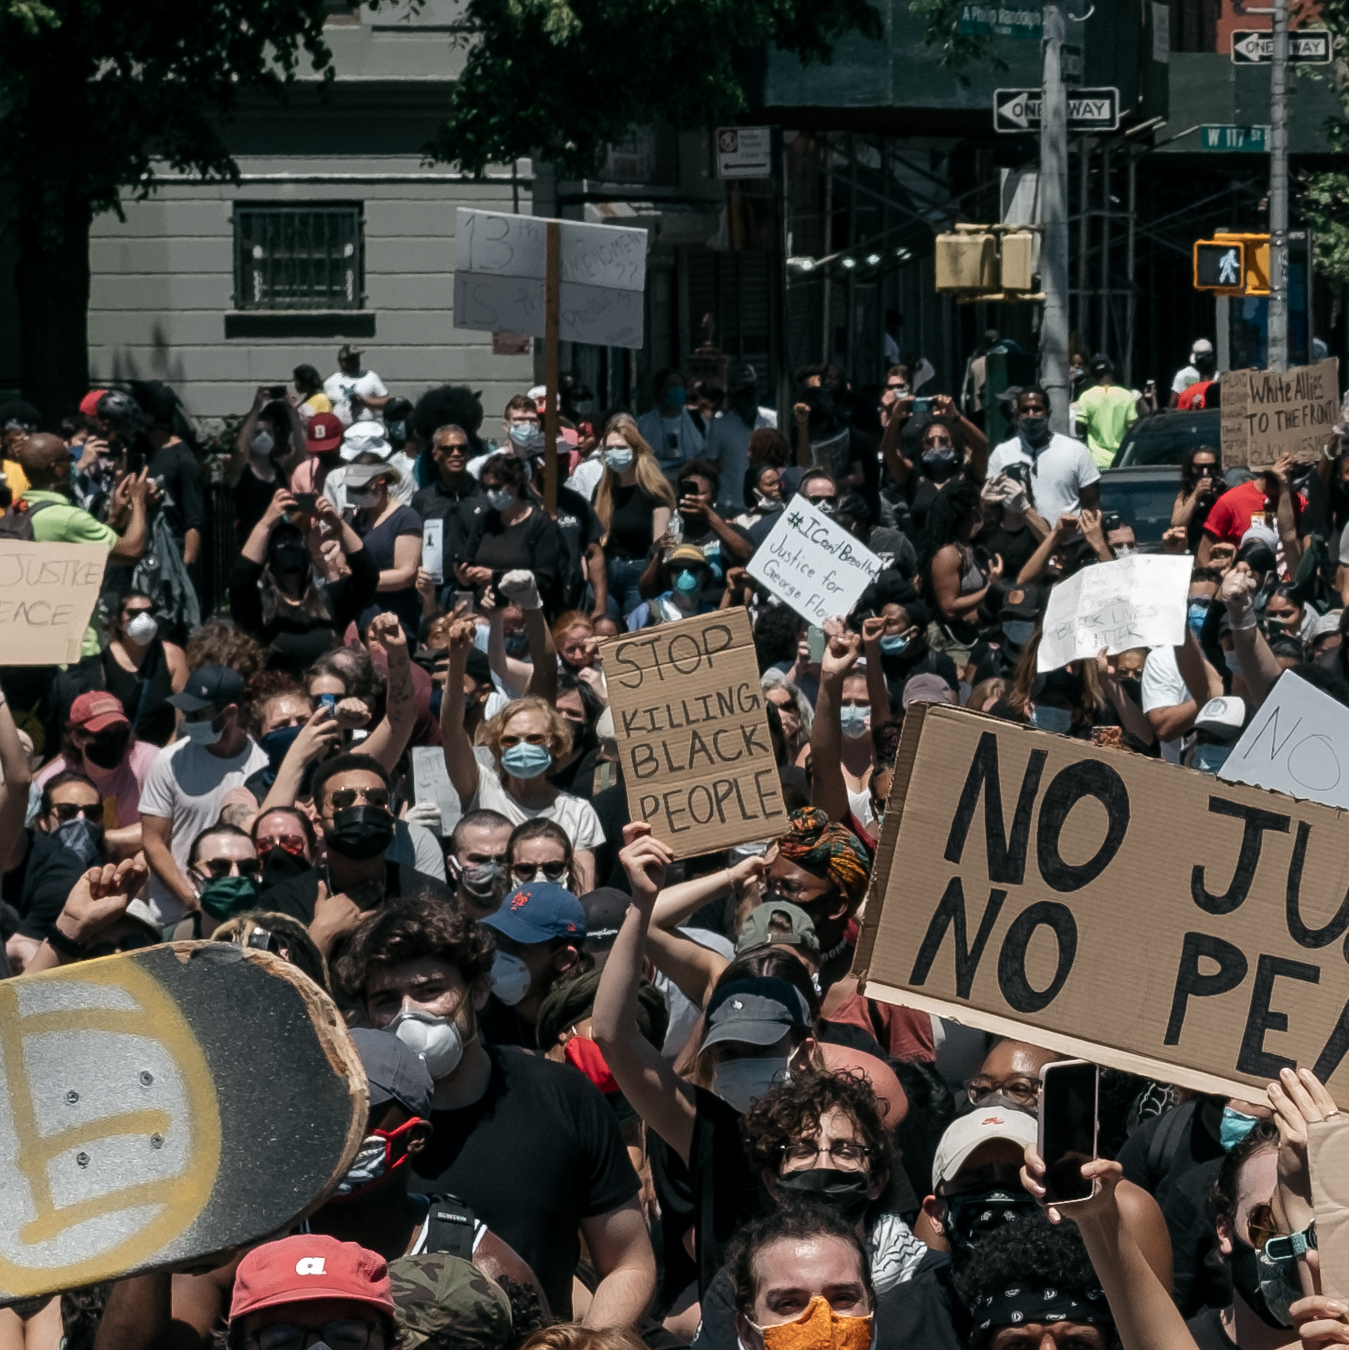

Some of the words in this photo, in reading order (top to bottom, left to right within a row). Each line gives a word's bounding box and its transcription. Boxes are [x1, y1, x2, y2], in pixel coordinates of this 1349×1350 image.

[1246, 41, 1273, 53] ONE
[1289, 41, 1322, 53] WAY
[1012, 102, 1043, 117] ONE
[1068, 102, 1103, 117] WAY
[1207, 128, 1221, 146] W
[1225, 128, 1245, 146] 117
[1249, 374, 1292, 404] White
[1245, 411, 1270, 437] TO
[1275, 407, 1303, 432] THE
[762, 558, 803, 599] George
[768, 534, 815, 579] Justice
[821, 570, 845, 595] for
[614, 625, 734, 689] STOP
[621, 683, 760, 738] KILLING
[629, 723, 770, 780] BLACK
[1242, 705, 1342, 793] NO
[639, 768, 784, 833] PEOPLE
[945, 730, 1134, 892] NO
[910, 875, 1082, 1014] NO
